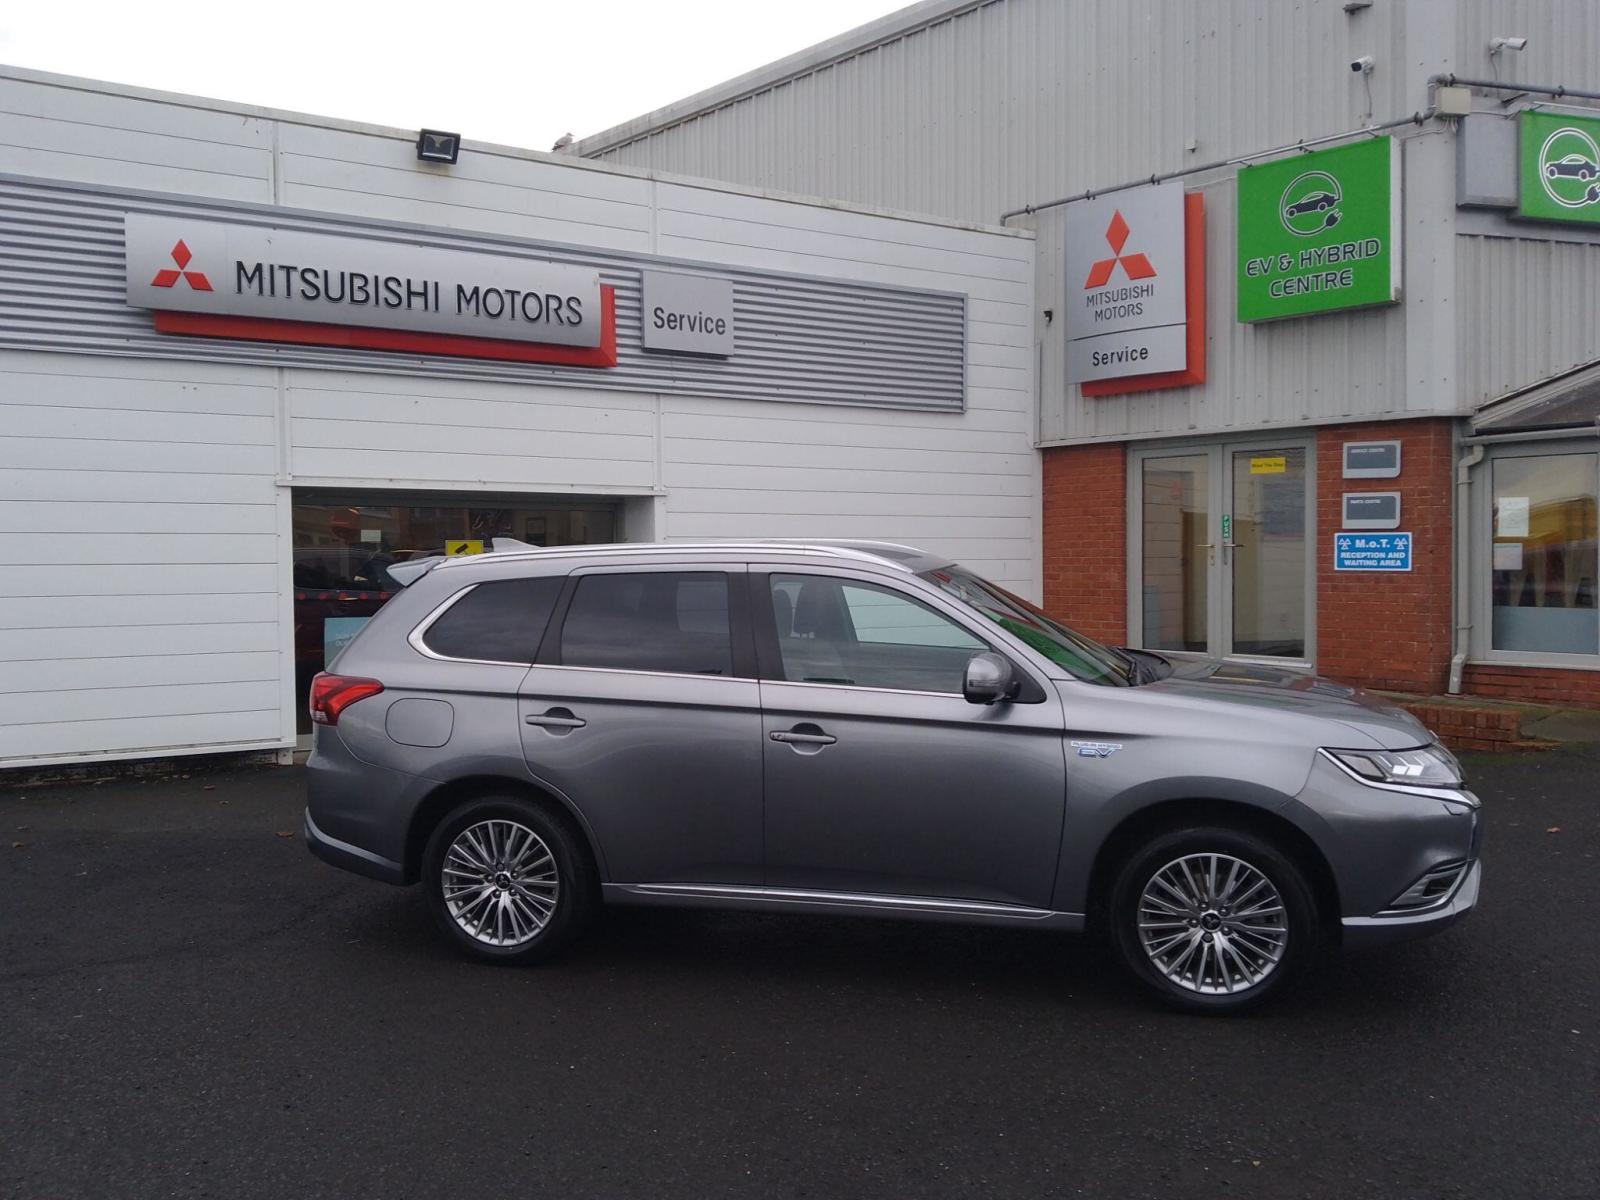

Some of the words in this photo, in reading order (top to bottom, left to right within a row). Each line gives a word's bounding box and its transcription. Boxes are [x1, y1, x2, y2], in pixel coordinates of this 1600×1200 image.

[1246, 257, 1279, 277] EV
[1279, 253, 1294, 272] &
[1299, 238, 1381, 269] HYBRID
[236, 260, 439, 312] MITSUBISHI
[456, 284, 583, 326] MOTORS
[1269, 268, 1353, 298] CENTRE
[1086, 283, 1154, 308] MITSUBISHI
[653, 306, 726, 336] Service
[1094, 302, 1143, 322] MOTORS
[1092, 346, 1149, 367] Service
[1355, 539, 1390, 548] M.o.T.
[1388, 551, 1406, 559] AND
[1380, 559, 1402, 567] AREA
